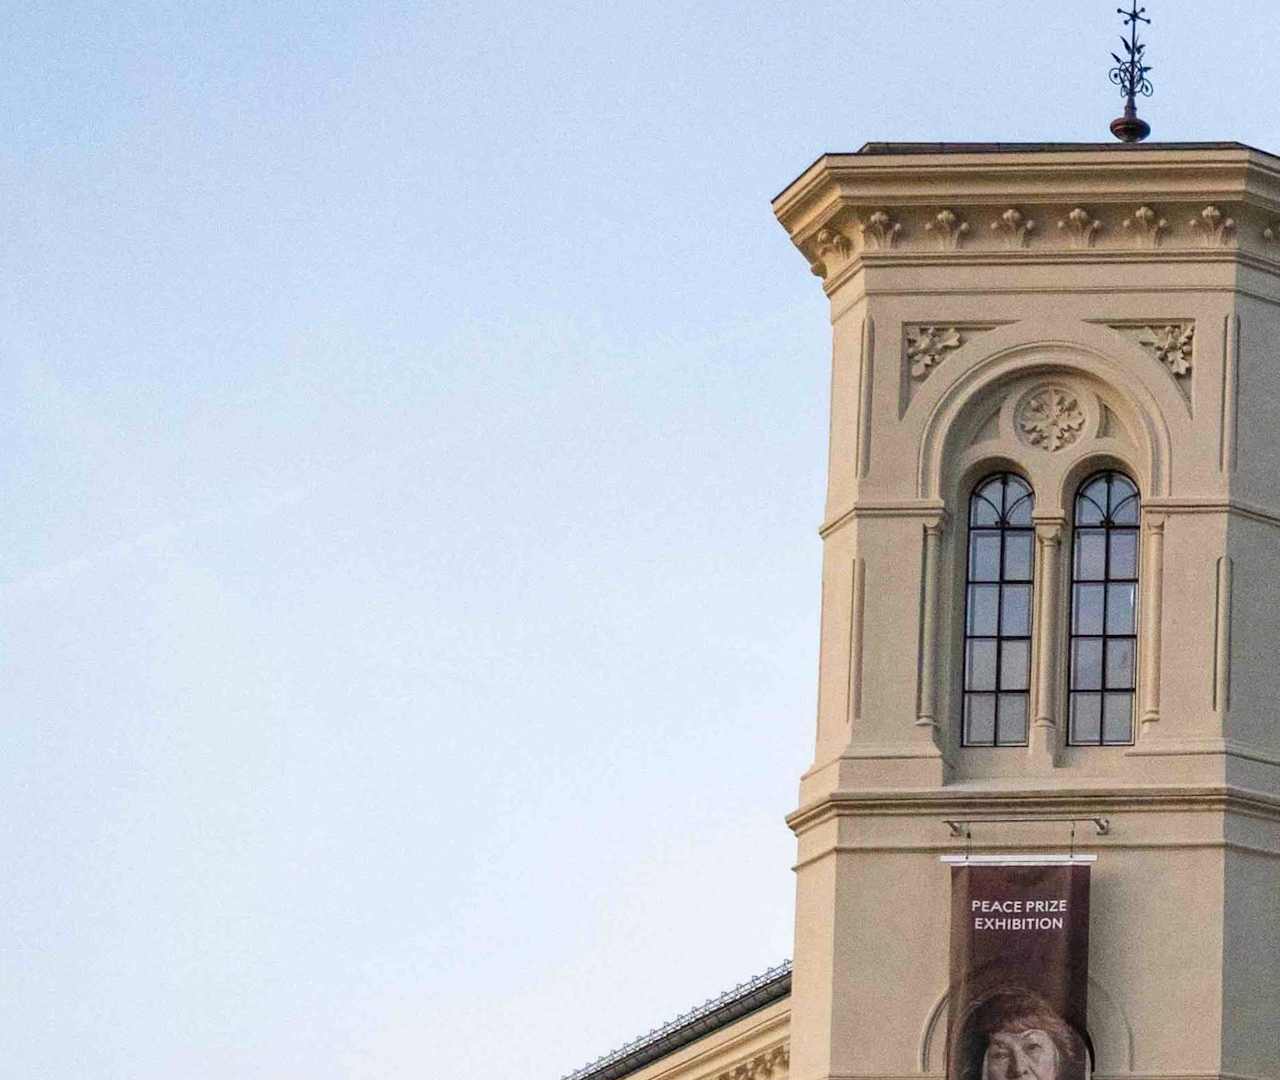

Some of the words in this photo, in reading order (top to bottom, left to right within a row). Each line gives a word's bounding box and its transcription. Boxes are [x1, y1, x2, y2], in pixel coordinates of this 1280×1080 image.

[971, 900, 1022, 913] PEACE
[1025, 899, 1068, 913] PRIZE
[974, 917, 1064, 930] EXHIBITION
